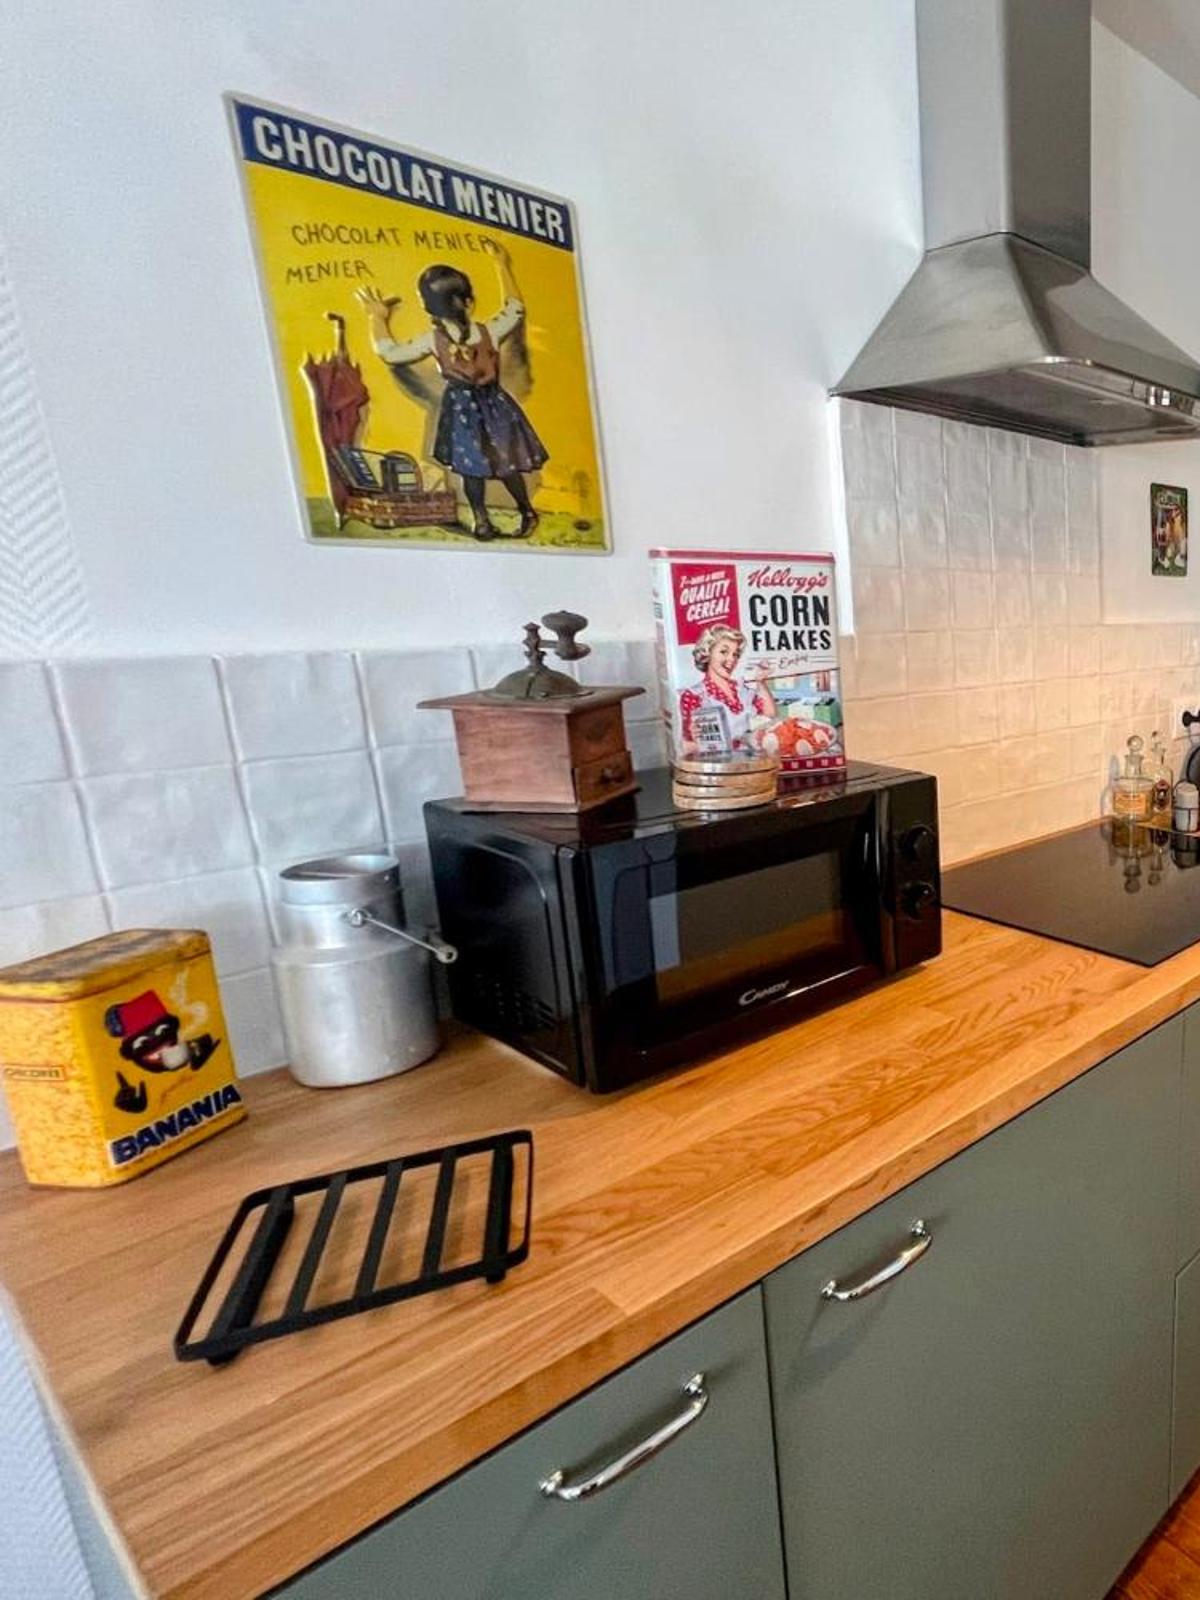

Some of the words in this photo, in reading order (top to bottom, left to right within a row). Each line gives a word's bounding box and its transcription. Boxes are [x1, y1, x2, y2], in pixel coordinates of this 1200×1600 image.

[253, 117, 446, 207] CHOCOLAT
[453, 176, 566, 243] MENIER
[291, 223, 402, 247] CHOCOLAT
[413, 230, 497, 254] MENIER
[286, 259, 375, 285] MENIER
[679, 578, 731, 606] QUALITY
[747, 566, 829, 594] Kellogg's
[686, 596, 731, 622] CEREAL
[748, 594, 831, 627] CORN
[751, 629, 832, 652] FLAKES
[111, 1084, 241, 1165] BANANIA
